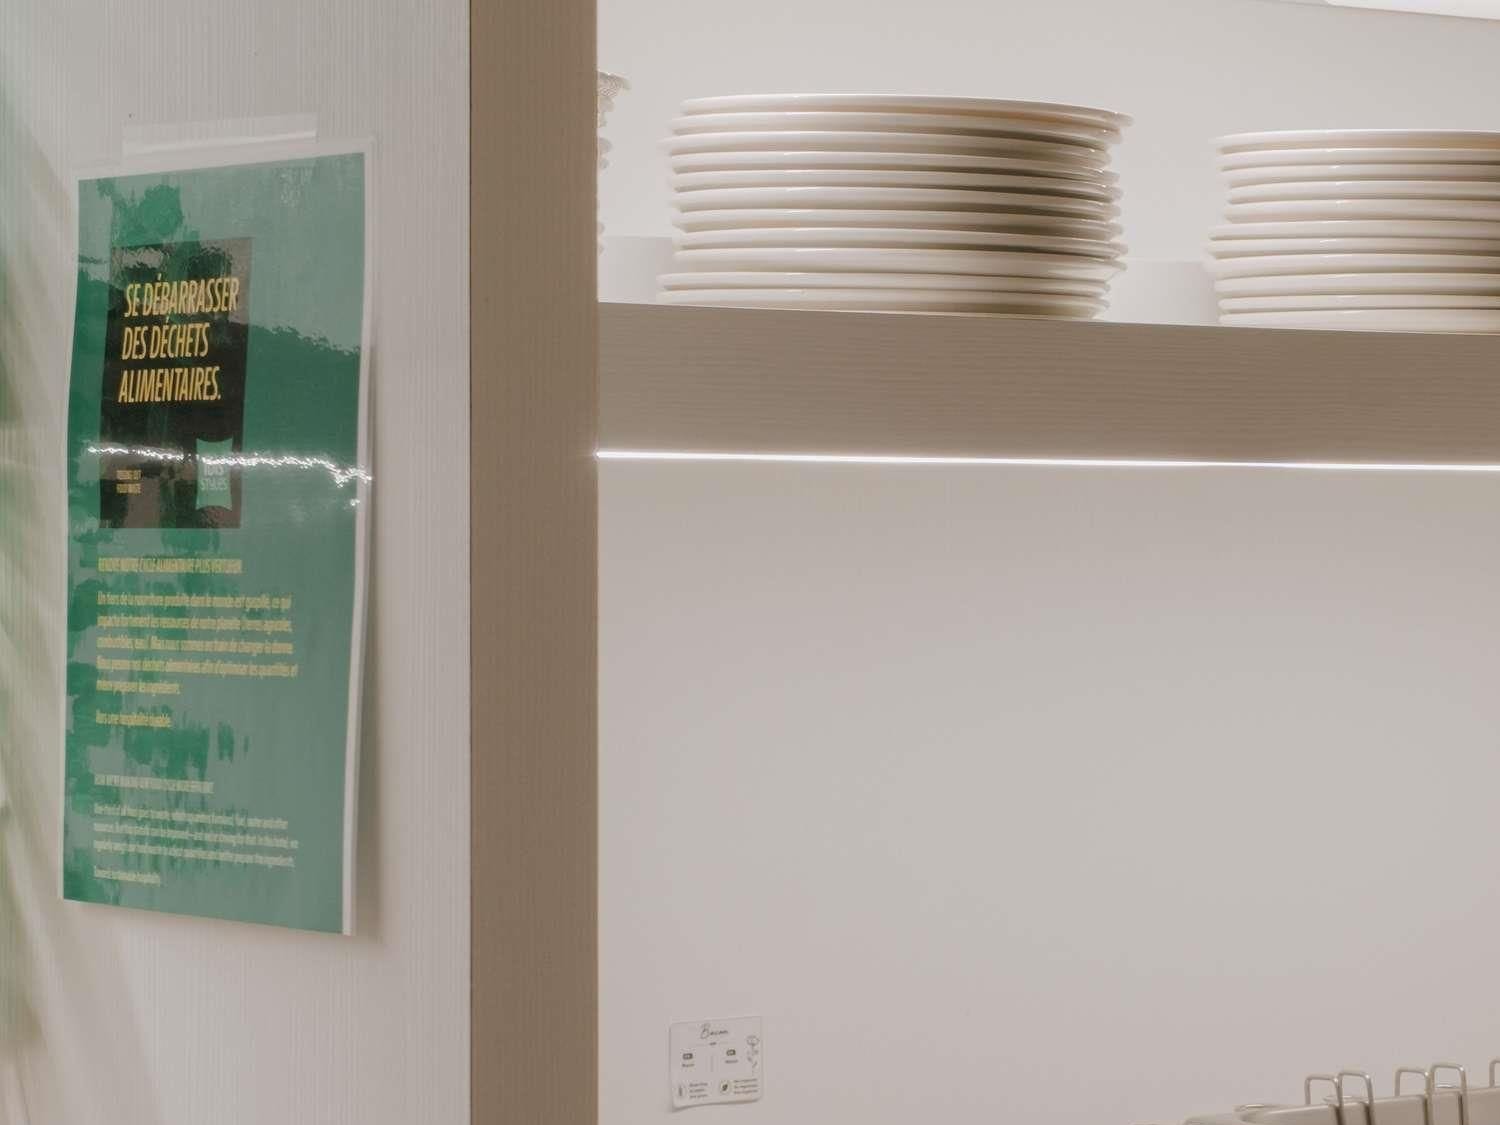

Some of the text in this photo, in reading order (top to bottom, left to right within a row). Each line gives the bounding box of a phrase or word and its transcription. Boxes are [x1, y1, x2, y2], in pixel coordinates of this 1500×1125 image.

[124, 273, 240, 318] SE DÉBARRASSER
[121, 316, 210, 360] DES DÉCHETS
[118, 366, 221, 403] ALIMENTAIRES.
